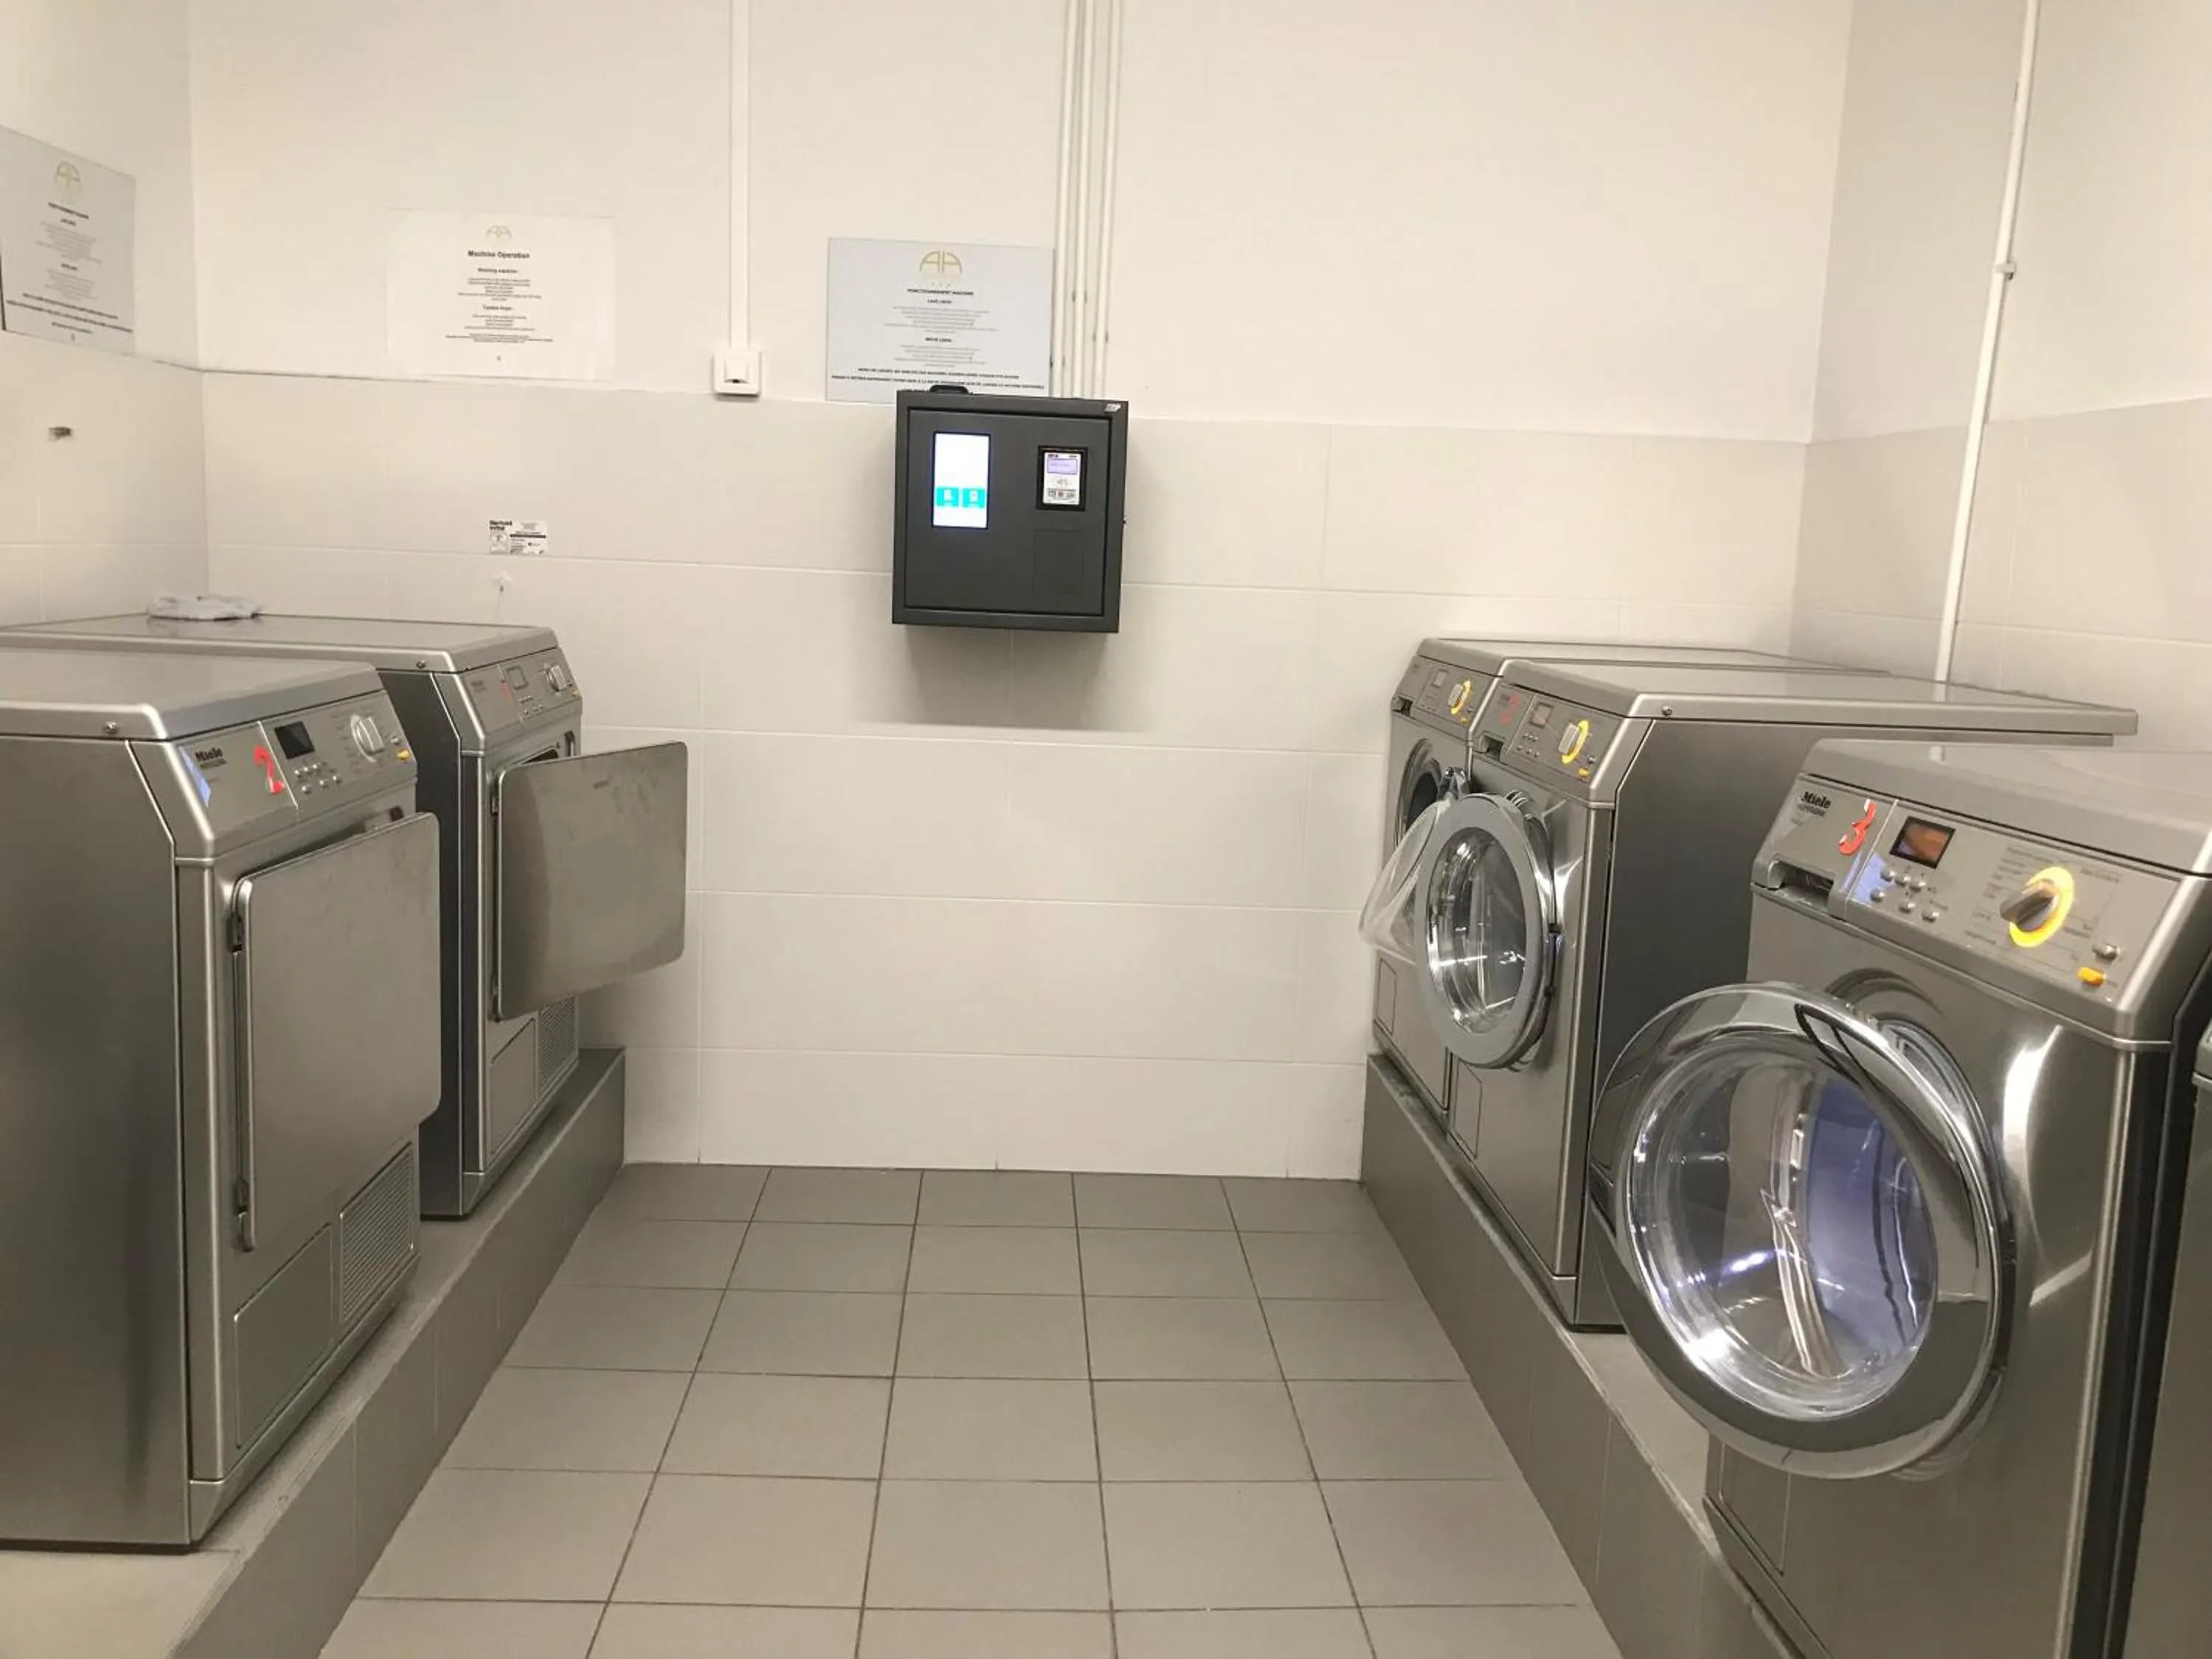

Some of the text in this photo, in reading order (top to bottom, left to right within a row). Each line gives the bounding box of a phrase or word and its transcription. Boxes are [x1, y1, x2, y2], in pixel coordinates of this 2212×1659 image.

[194, 746, 223, 762] Miele
[1801, 791, 1832, 809] Miele
[1839, 799, 1877, 855] 3
